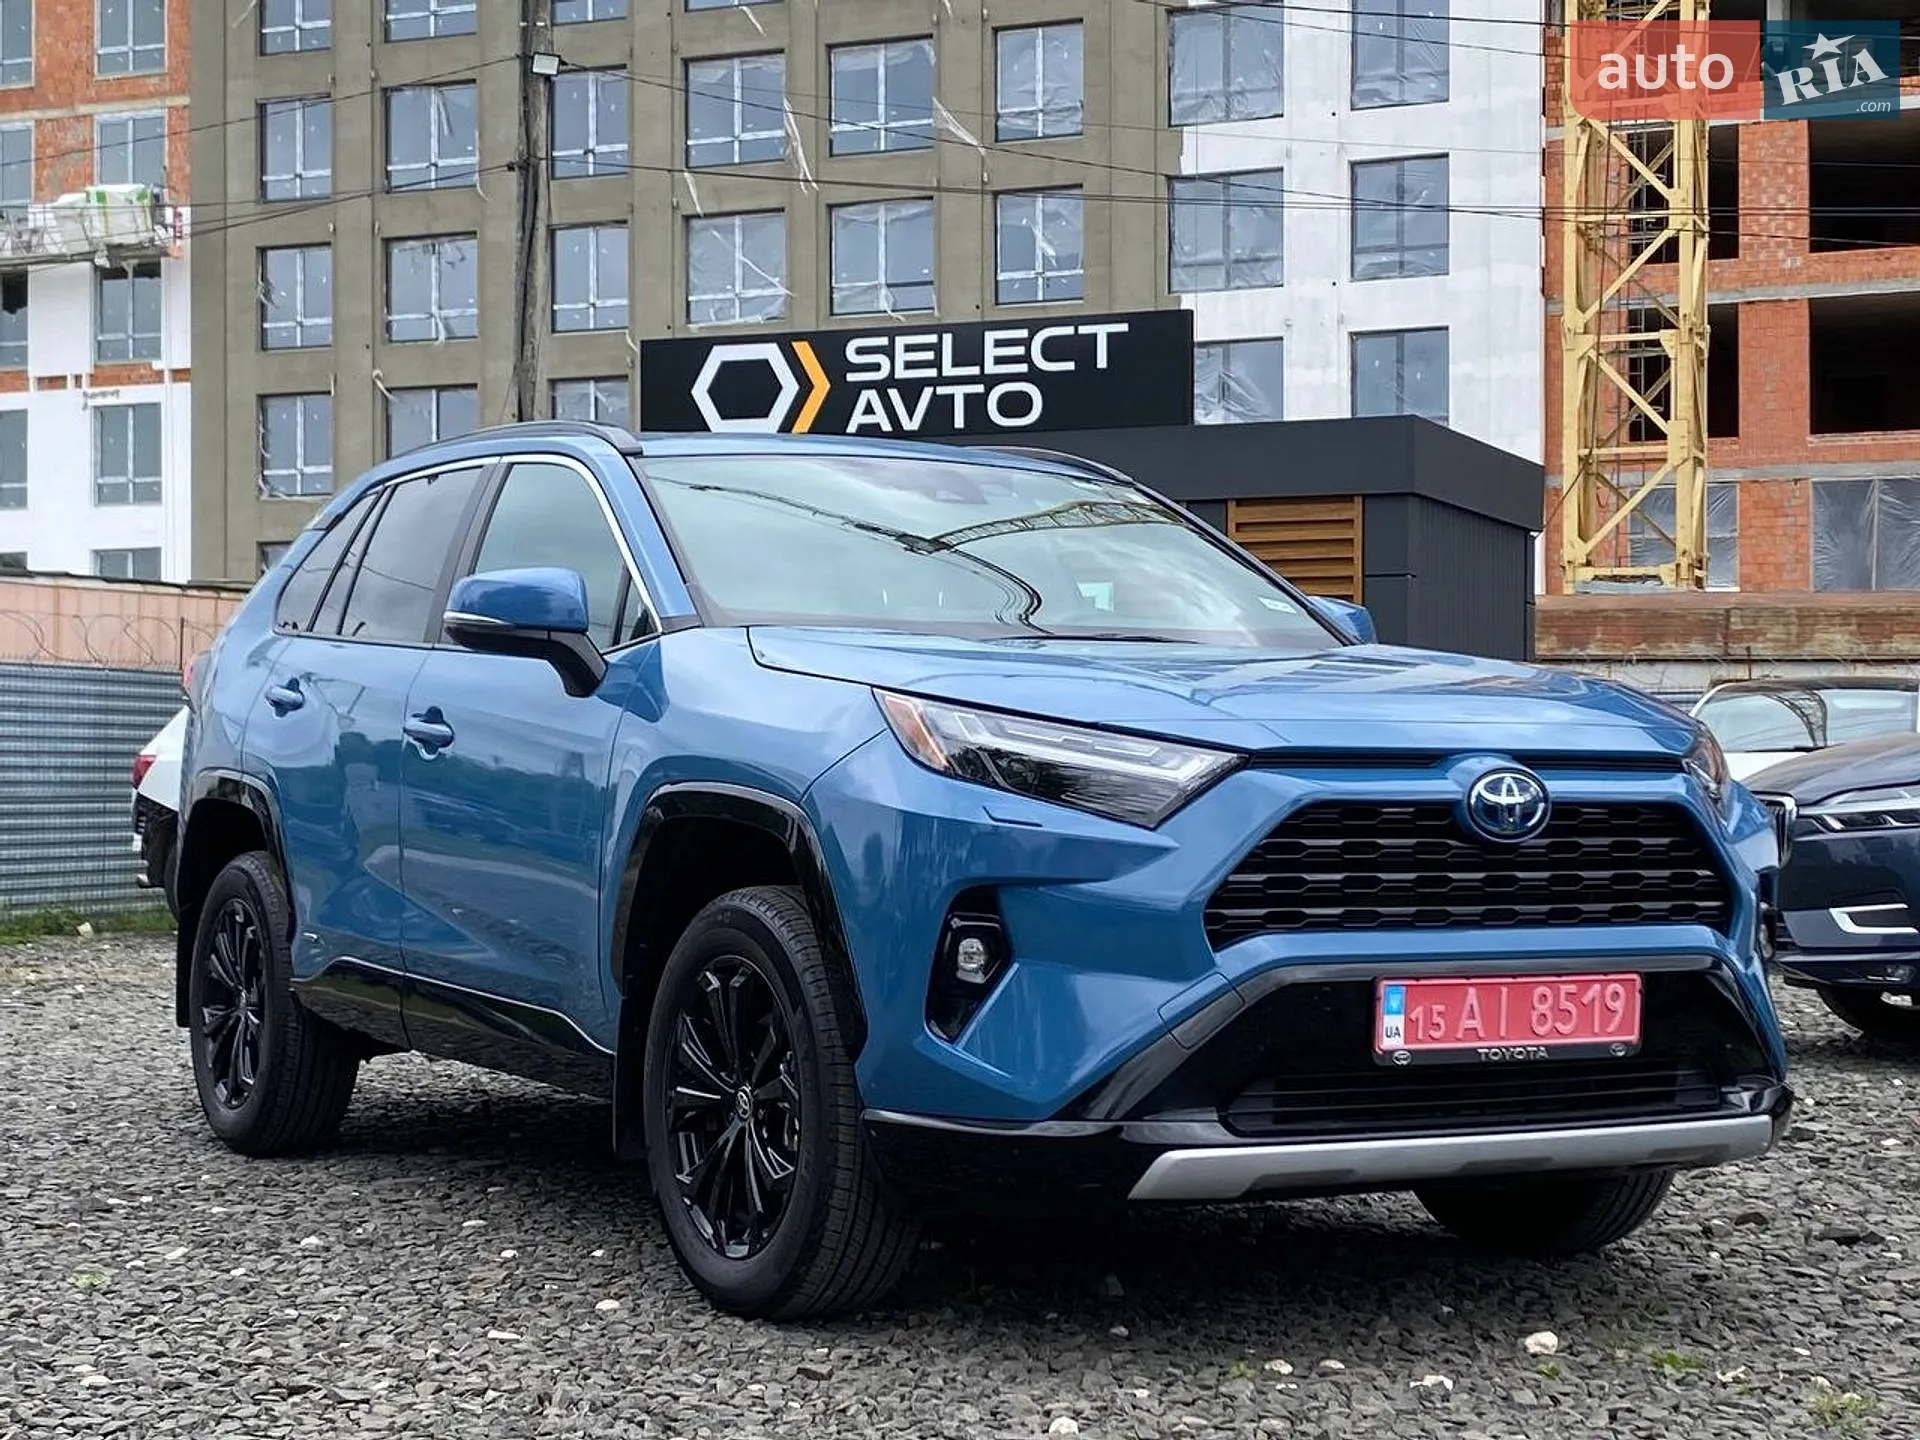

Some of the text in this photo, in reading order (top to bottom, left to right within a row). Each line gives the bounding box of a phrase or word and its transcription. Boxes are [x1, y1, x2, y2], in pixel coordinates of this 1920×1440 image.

[846, 323, 1129, 382] SELECT
[846, 382, 1043, 433] AVTO
[1385, 1026, 1401, 1039] UA
[1409, 983, 1627, 1040] 15 AI 8519
[1477, 1047, 1549, 1062] TOYOTA
